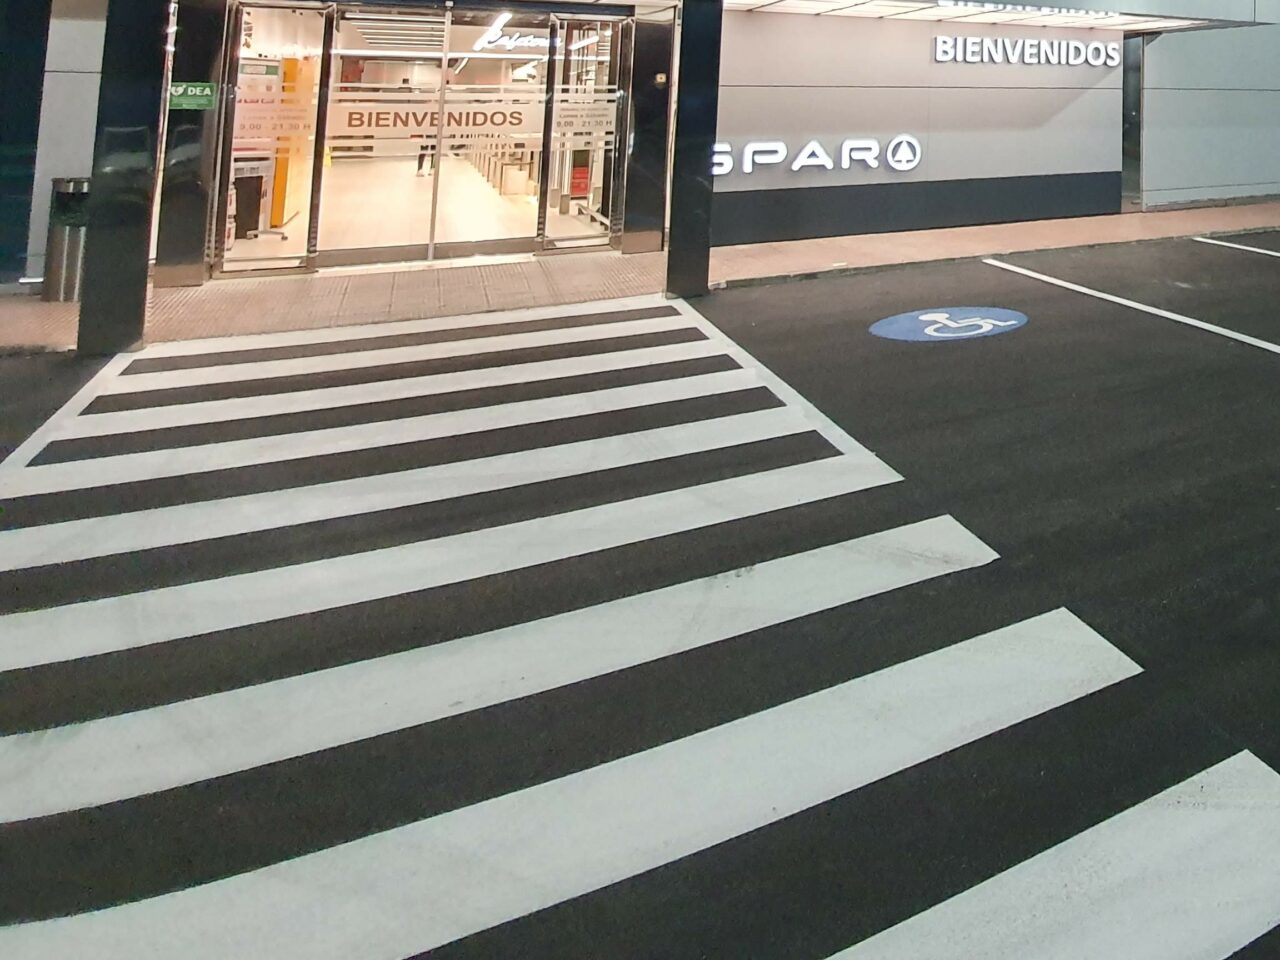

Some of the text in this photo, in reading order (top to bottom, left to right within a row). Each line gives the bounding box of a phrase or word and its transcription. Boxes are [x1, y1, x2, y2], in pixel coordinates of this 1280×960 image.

[935, 35, 1121, 67] BIENVENIDOS
[187, 86, 212, 96] DEA
[347, 111, 523, 127] BIENVENIDOS
